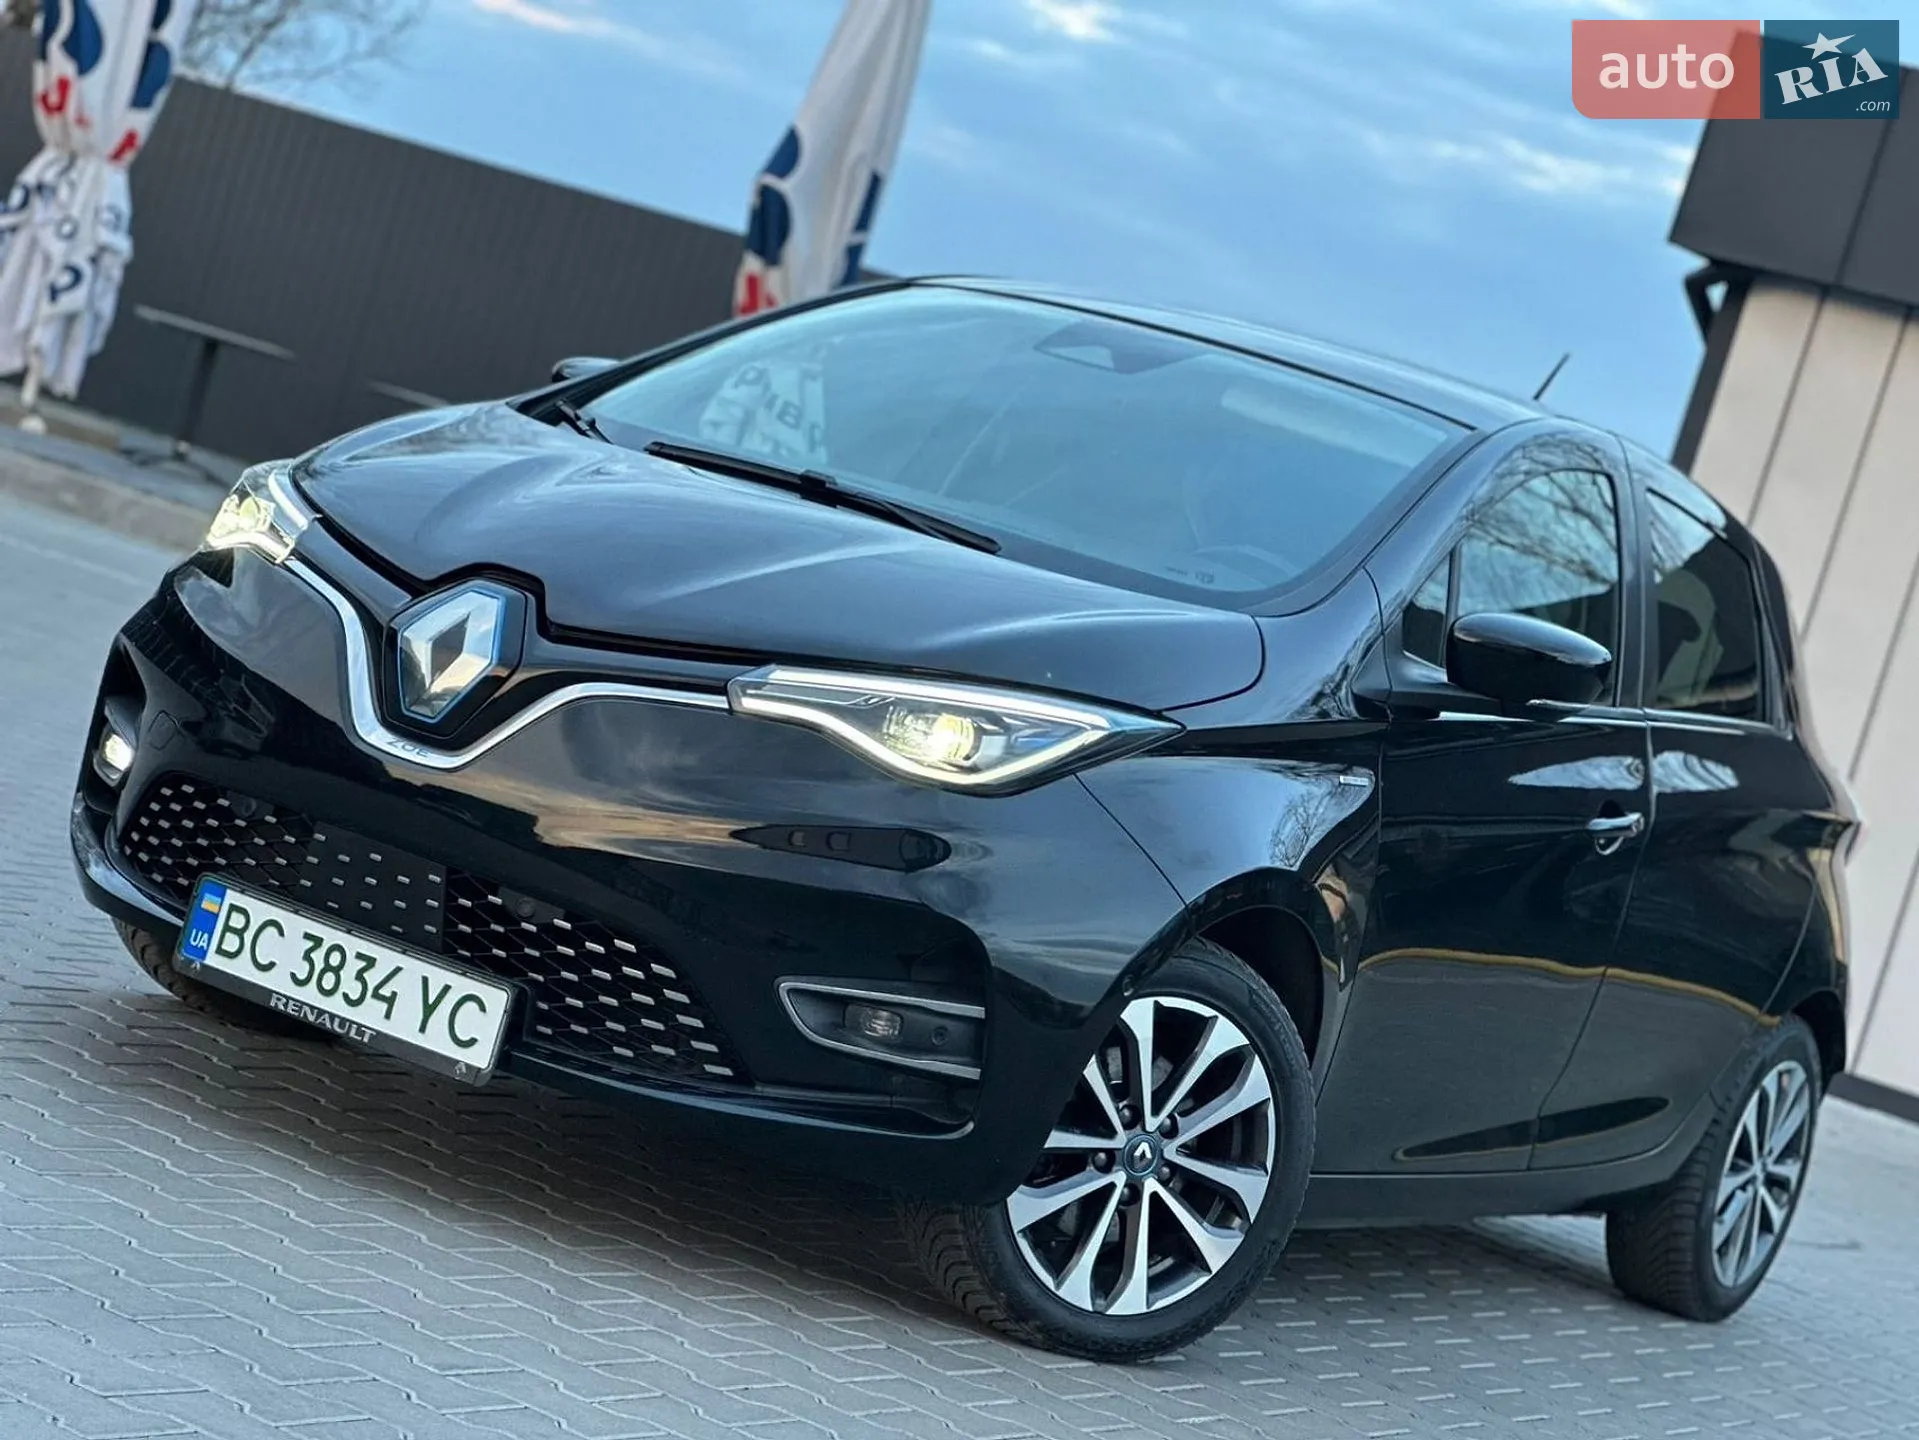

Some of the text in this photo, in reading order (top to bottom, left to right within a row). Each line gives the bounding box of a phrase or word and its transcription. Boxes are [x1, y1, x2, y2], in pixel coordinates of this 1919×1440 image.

[189, 927, 209, 950] UA
[215, 903, 488, 1049] BC 3834 YC
[269, 992, 377, 1044] RENAULT
